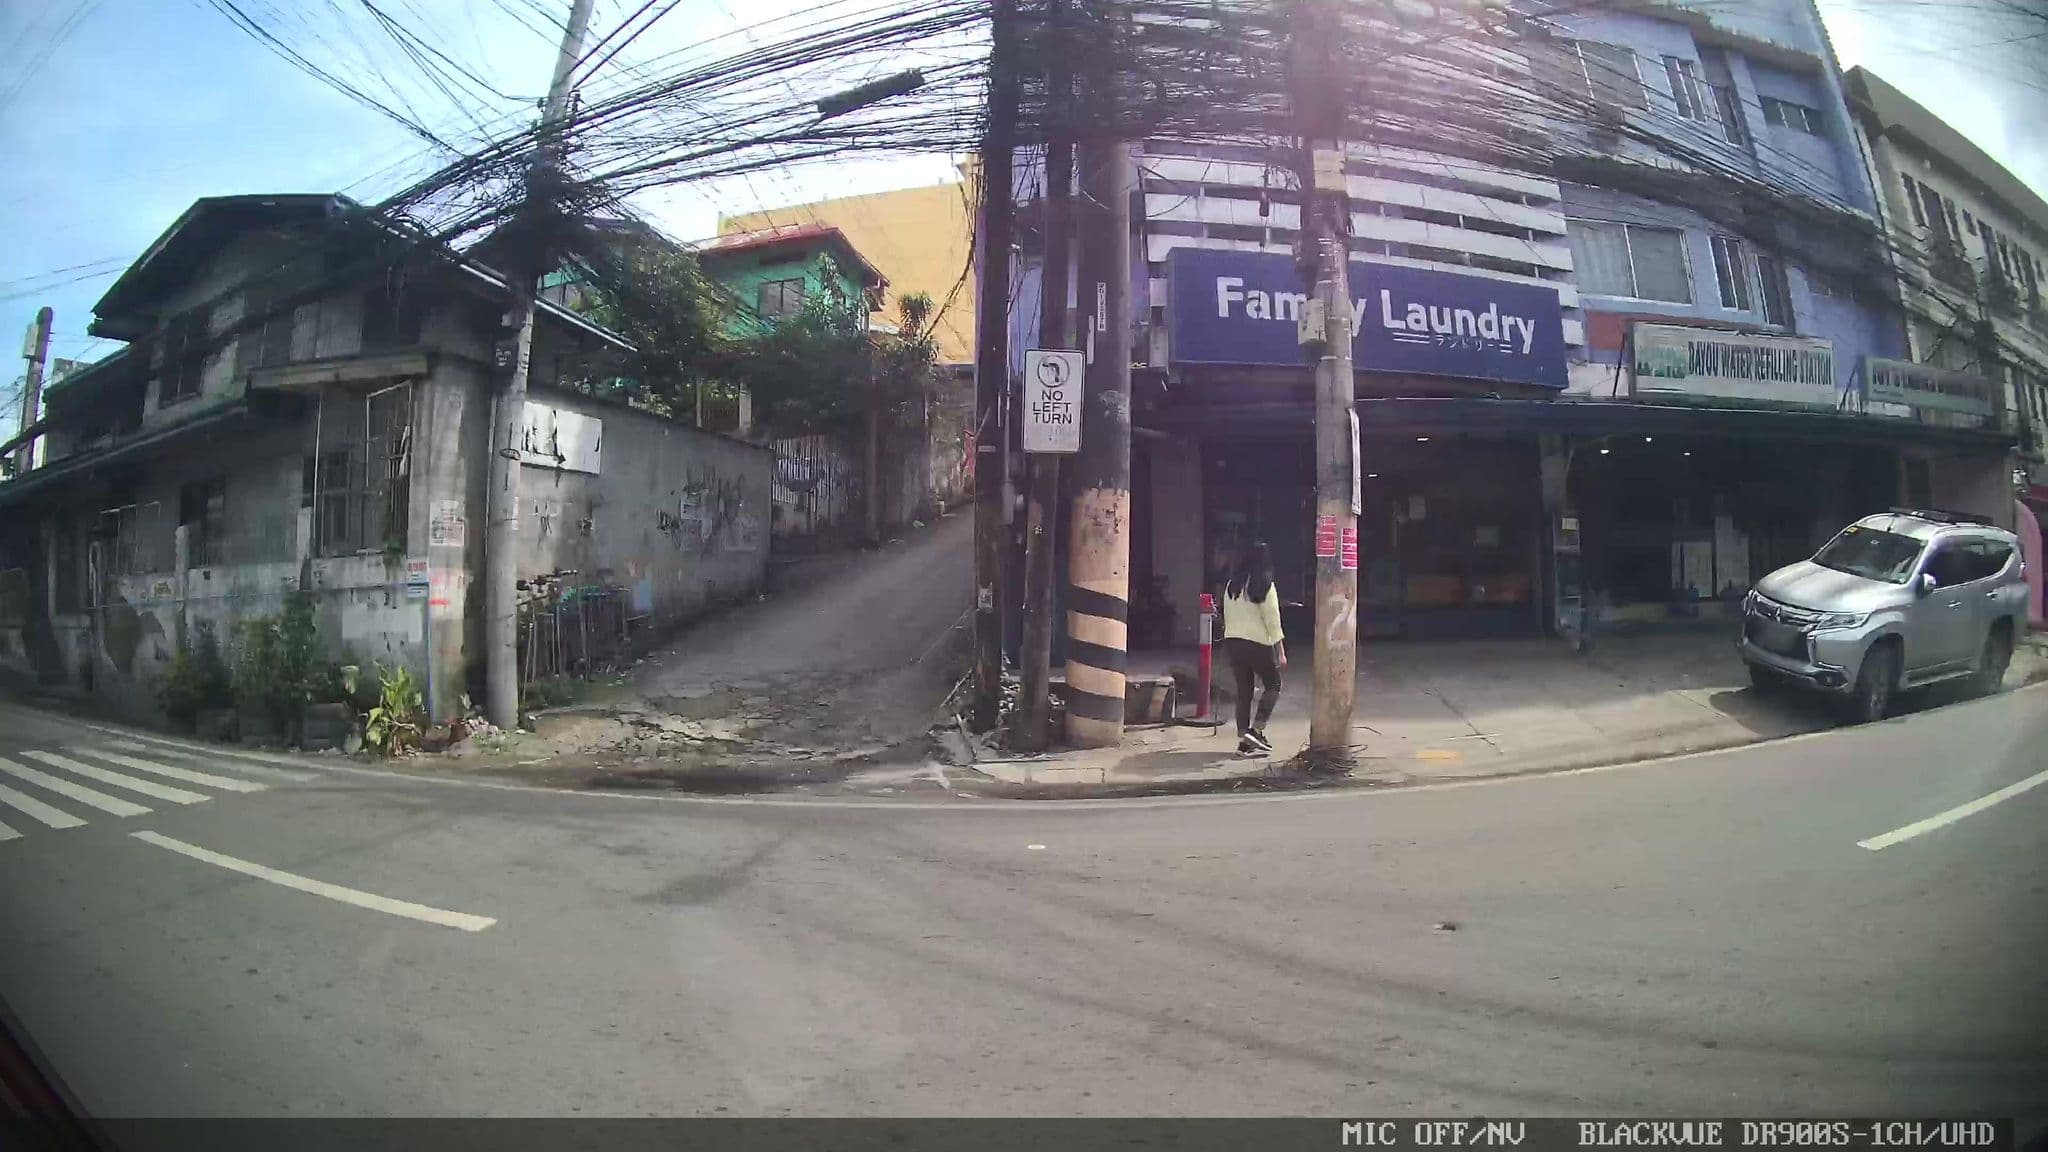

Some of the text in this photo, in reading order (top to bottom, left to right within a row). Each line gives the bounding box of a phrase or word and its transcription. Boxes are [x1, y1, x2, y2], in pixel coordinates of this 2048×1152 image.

[1216, 276, 1535, 354] Famy Laundry
[1721, 343, 1753, 381] WATER
[1754, 346, 1798, 383] REFILLING
[1799, 349, 1832, 386] STATION
[1041, 390, 1064, 401] NO
[1033, 402, 1072, 412] LEFT
[1033, 413, 1072, 424] TURN
